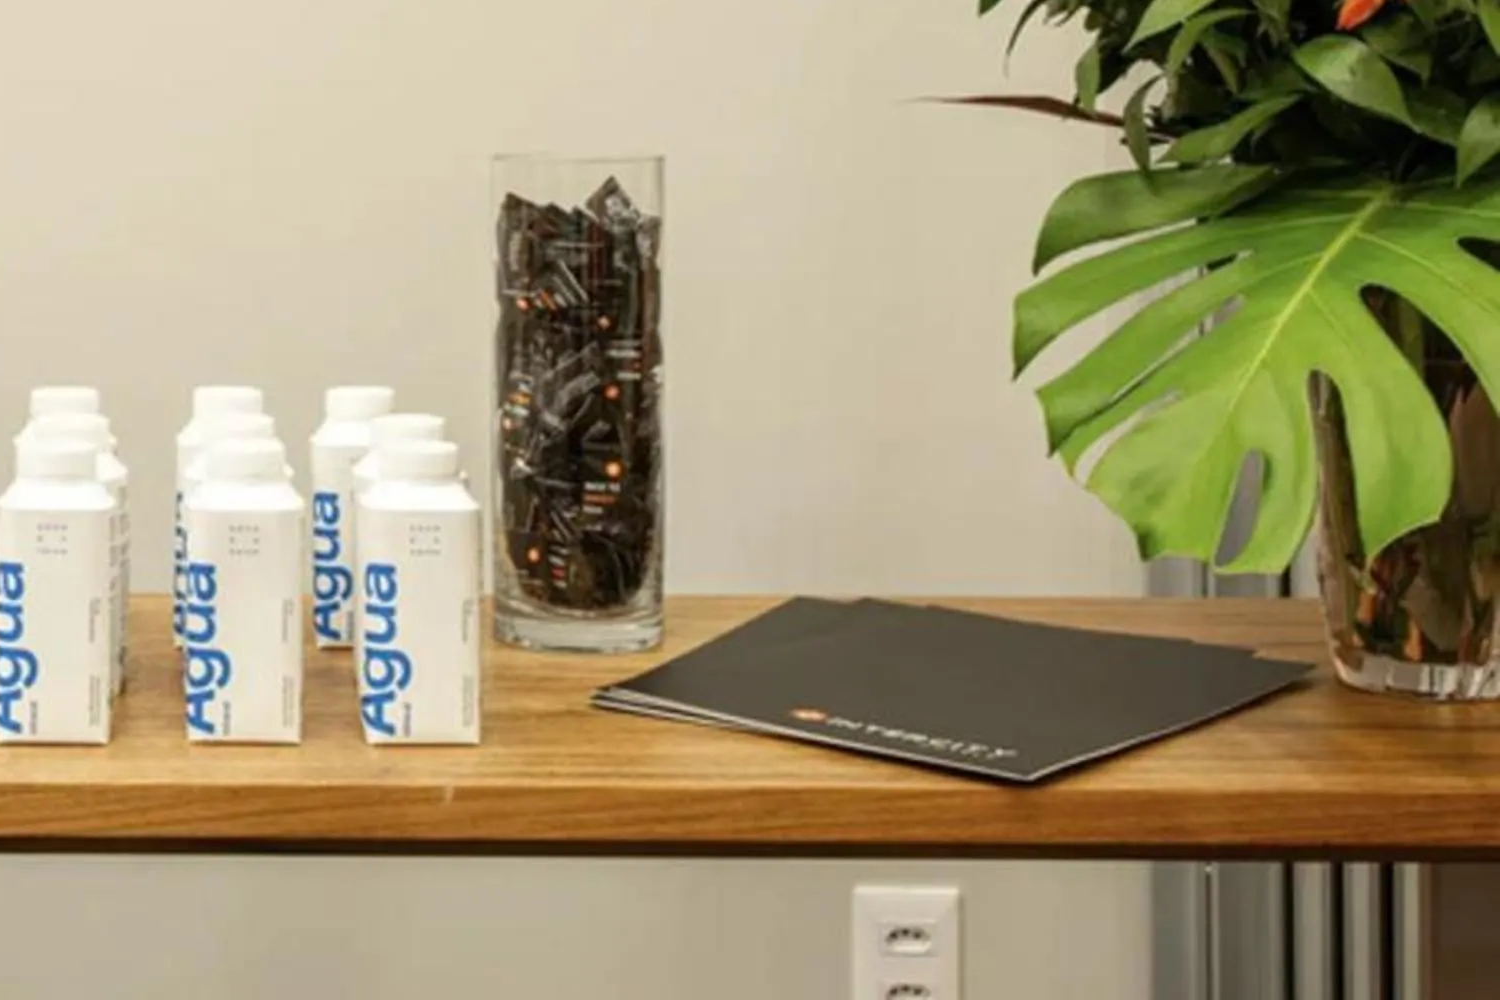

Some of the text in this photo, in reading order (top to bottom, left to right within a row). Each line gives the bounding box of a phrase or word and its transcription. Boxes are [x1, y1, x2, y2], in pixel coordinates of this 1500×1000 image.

[312, 491, 354, 641] Agua
[184, 561, 232, 735] Agua
[361, 561, 413, 737] Agua
[826, 716, 1018, 759] INTERCITY
